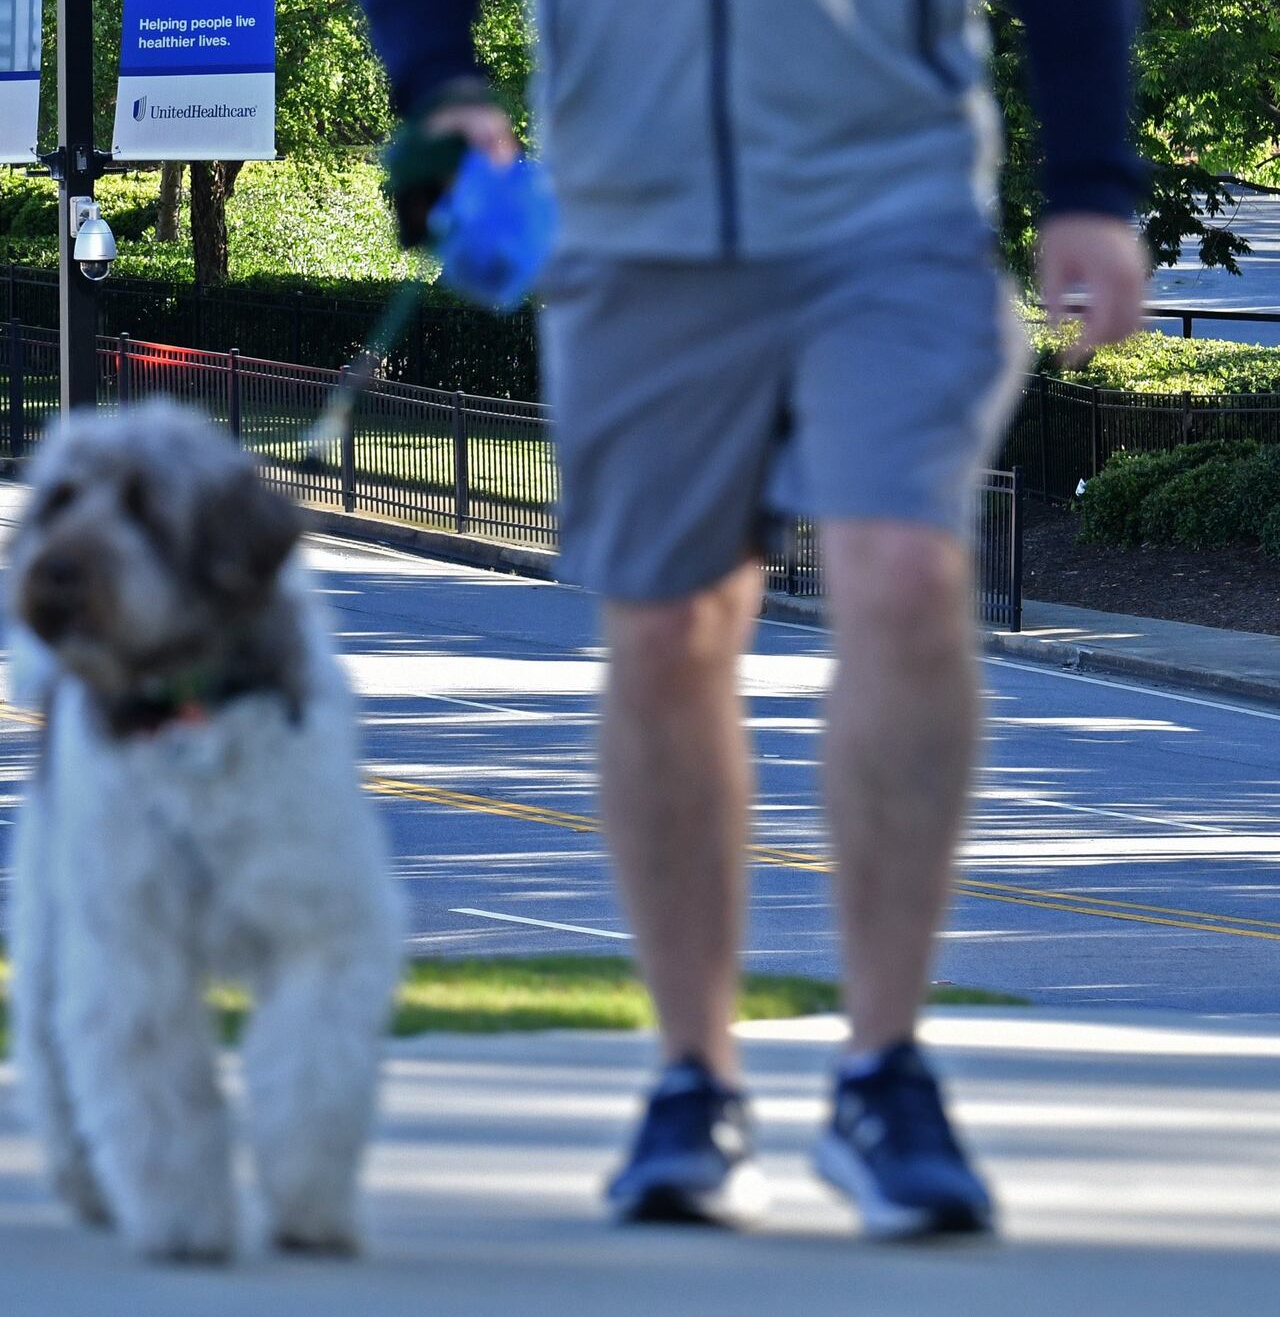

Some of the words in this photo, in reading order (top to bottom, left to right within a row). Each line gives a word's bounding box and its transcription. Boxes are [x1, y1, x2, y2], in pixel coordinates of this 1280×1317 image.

[139, 17, 188, 32] Helping
[190, 15, 232, 31] people
[235, 15, 256, 27] live
[138, 35, 196, 49] healthier
[198, 35, 231, 47] lives.
[150, 103, 257, 119] UnitedHealthcare
